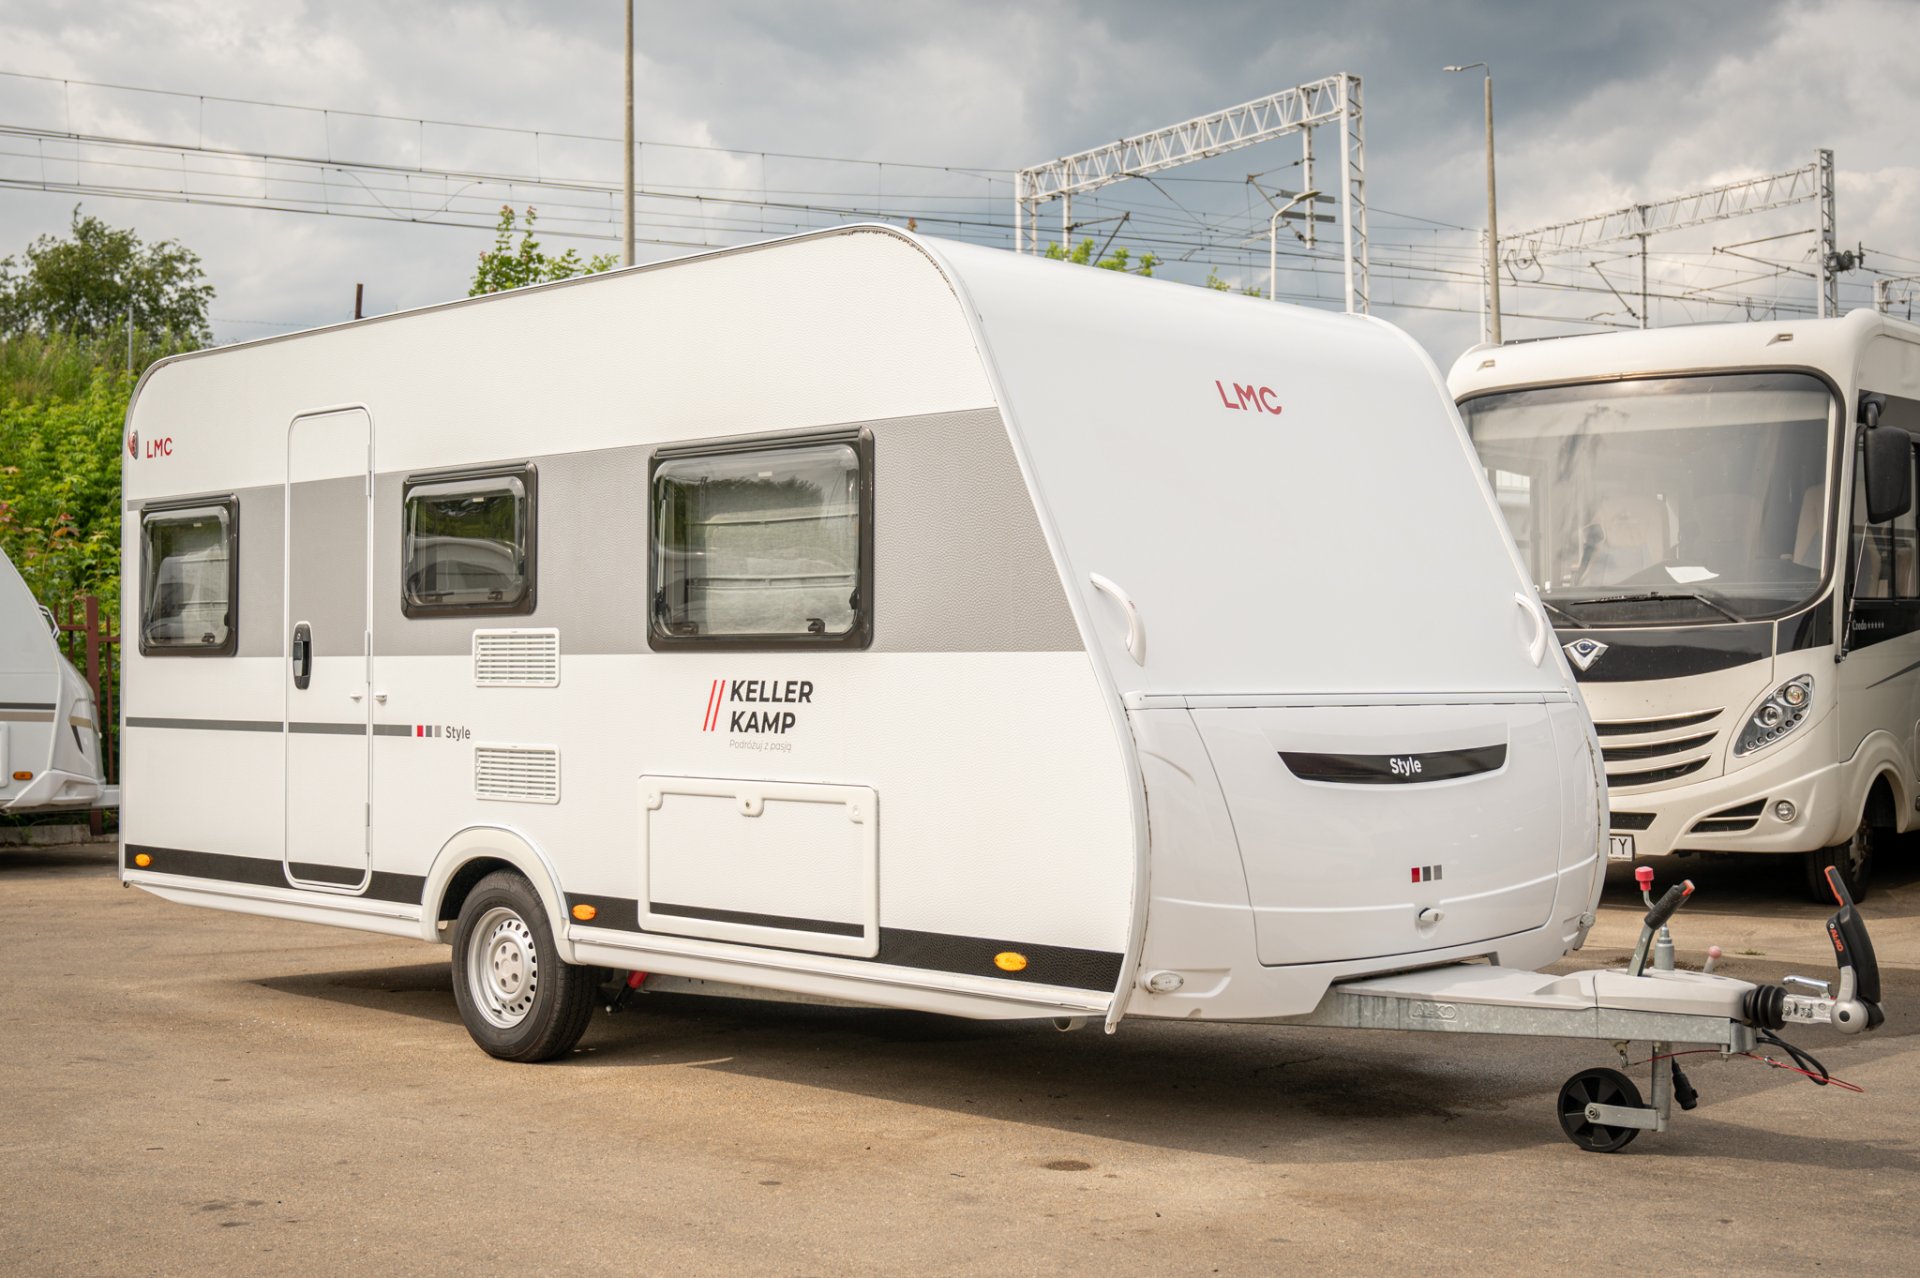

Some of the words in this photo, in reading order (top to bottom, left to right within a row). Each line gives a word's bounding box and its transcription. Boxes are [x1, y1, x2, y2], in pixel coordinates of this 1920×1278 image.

[1215, 379, 1282, 415] LMC
[146, 437, 173, 459] LMC
[729, 680, 814, 703] KELLER
[445, 725, 471, 741] Style
[729, 710, 796, 734] KAMP
[1390, 756, 1422, 776] Style
